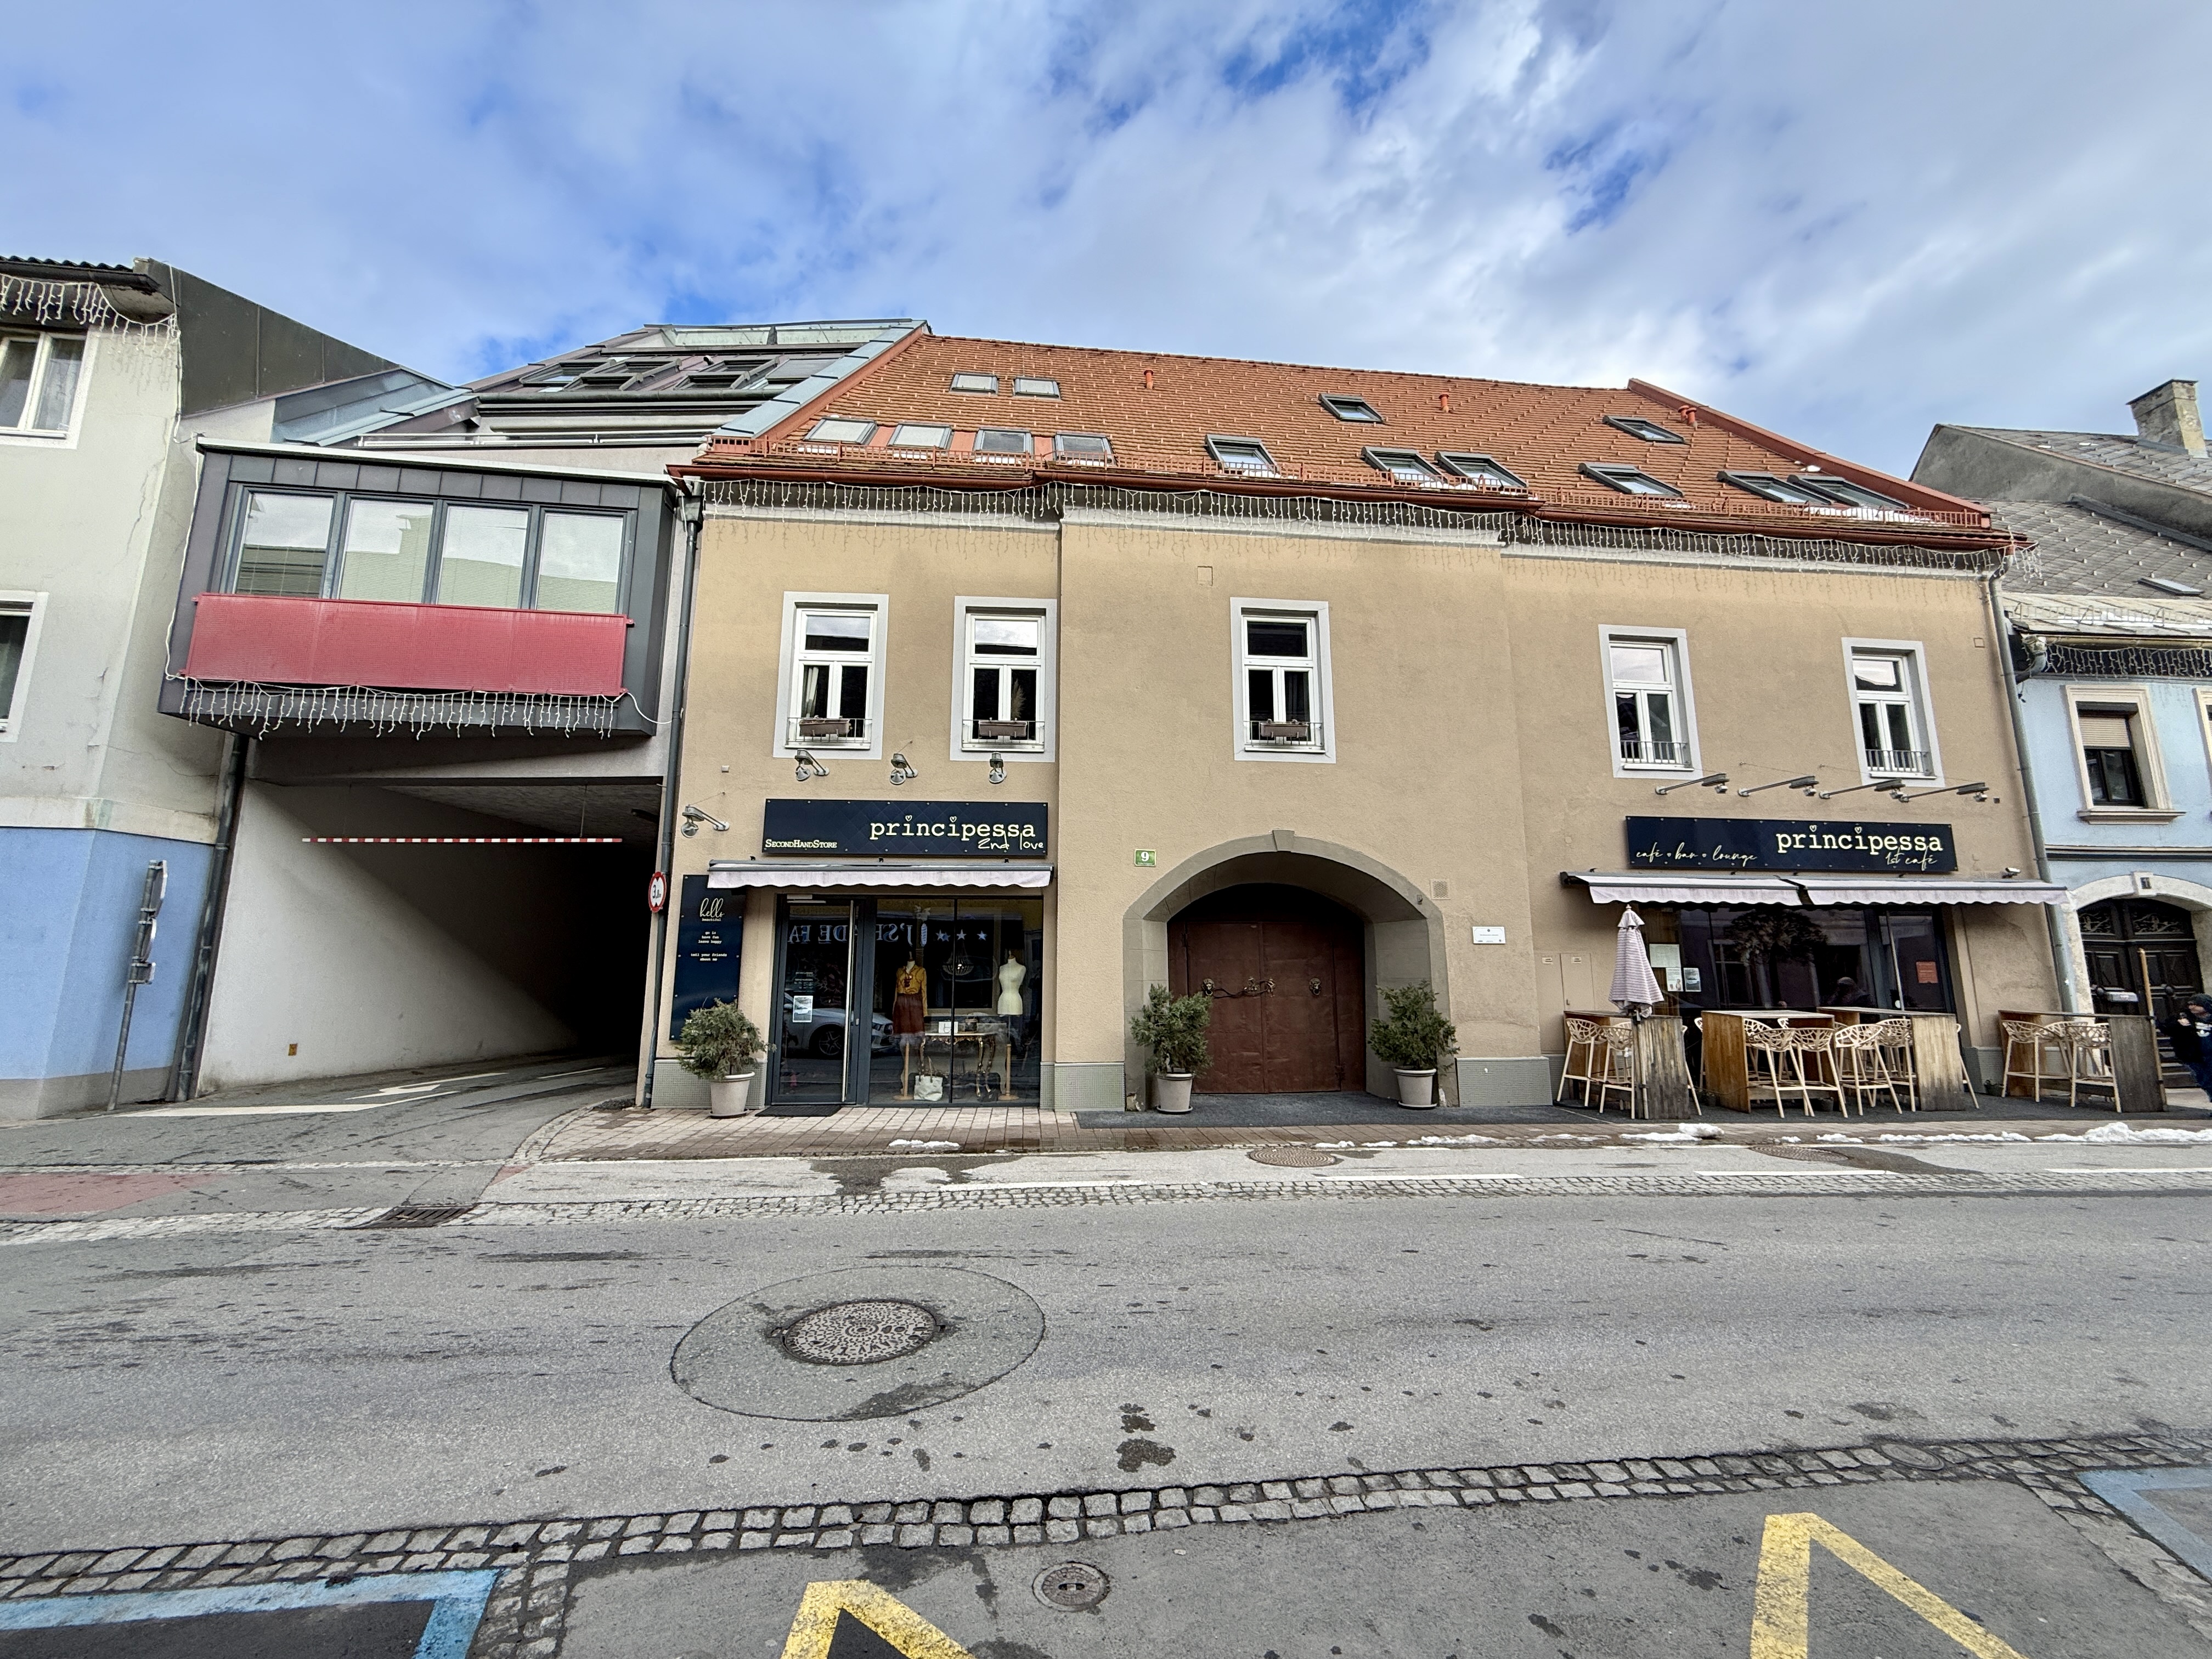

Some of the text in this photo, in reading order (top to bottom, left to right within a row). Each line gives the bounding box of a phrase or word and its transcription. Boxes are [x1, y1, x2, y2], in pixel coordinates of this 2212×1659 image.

[870, 815, 1036, 841] principessa
[978, 830, 1044, 850] 2nd love
[1776, 825, 1943, 855] principessa
[1141, 851, 1149, 862] 9
[1636, 842, 1758, 867] café bar lounge
[1885, 845, 1938, 871] 1st café
[699, 898, 725, 918] hello
